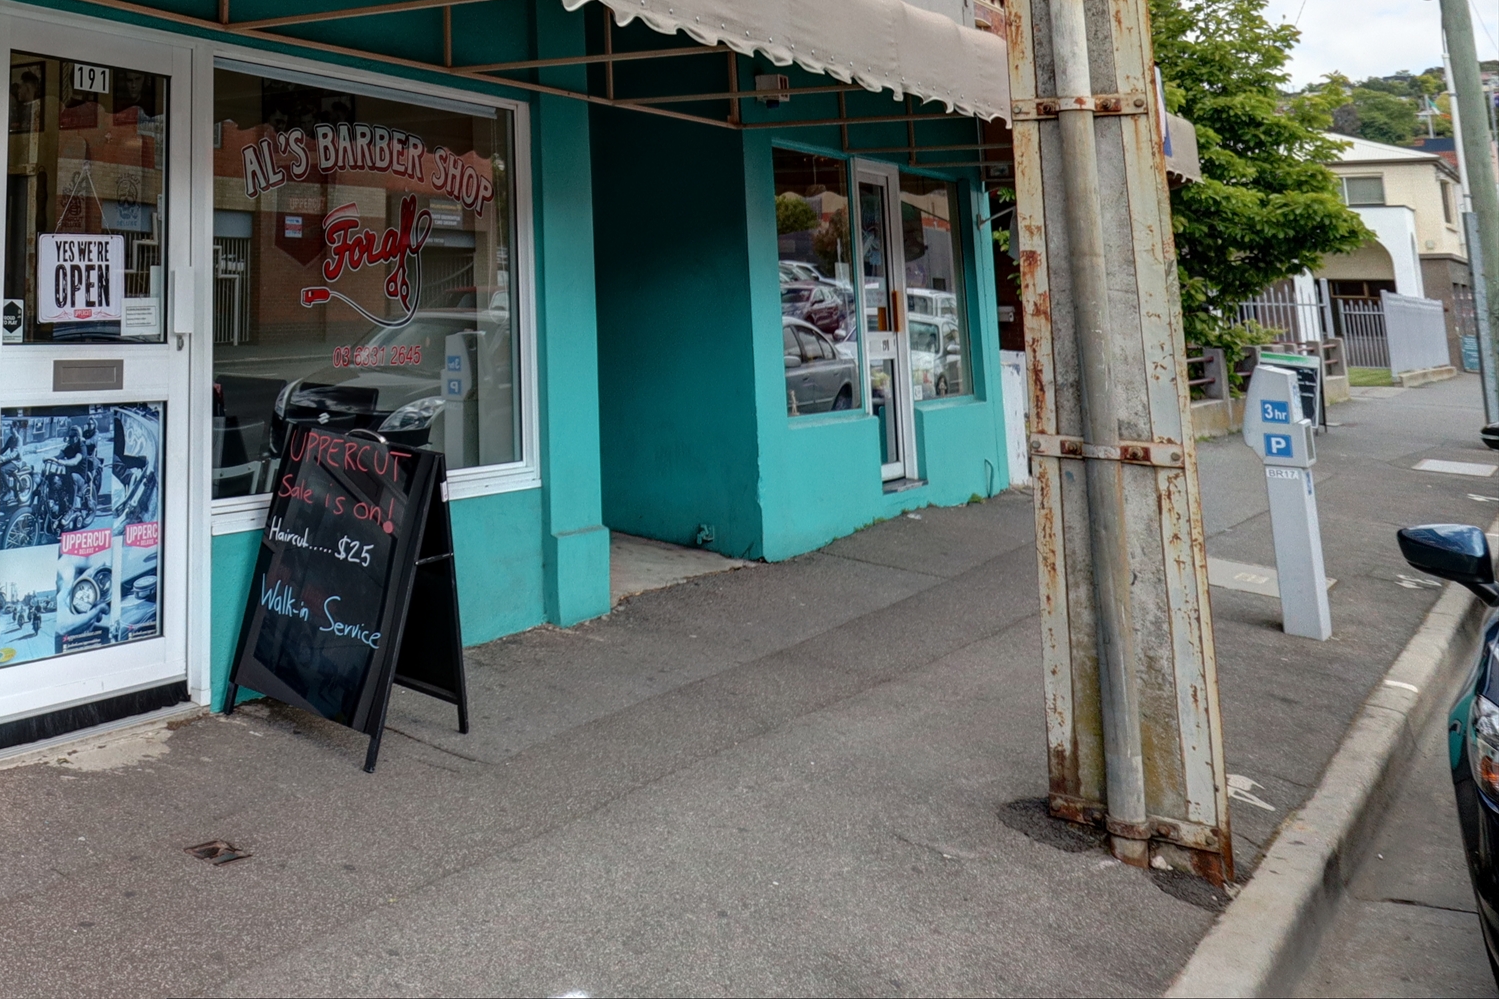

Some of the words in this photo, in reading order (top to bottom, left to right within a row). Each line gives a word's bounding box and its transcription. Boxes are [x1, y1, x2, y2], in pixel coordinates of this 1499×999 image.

[77, 66, 106, 92] 191
[242, 127, 310, 199] AL'S
[314, 122, 425, 184] BARBER
[430, 145, 495, 219] SHOP
[55, 240, 76, 263] YES
[77, 240, 110, 263] WE'RE
[54, 264, 111, 309] OPEN
[333, 345, 350, 368] 03
[354, 345, 386, 368] 6331
[389, 344, 421, 366] 2645
[290, 429, 412, 482] UPPERCUT
[1271, 437, 1286, 454] P
[278, 473, 314, 504] Sale
[325, 483, 346, 515] is
[353, 497, 395, 534] on!
[62, 530, 111, 552] UPPERCUT
[260, 573, 309, 622] Walk-in
[319, 595, 382, 649] Service
